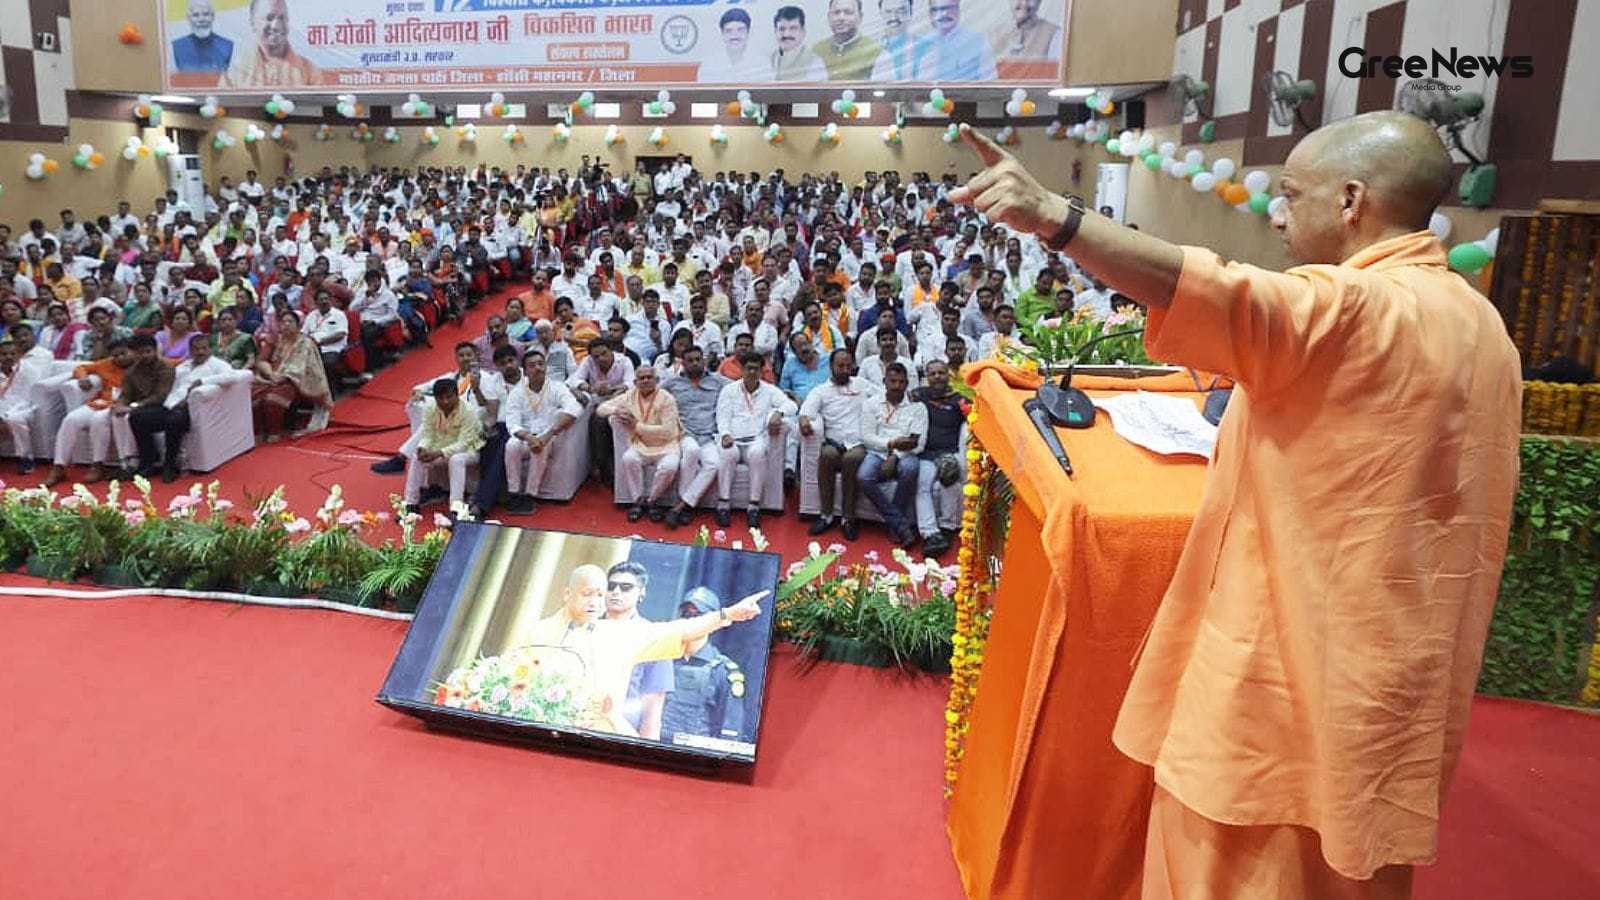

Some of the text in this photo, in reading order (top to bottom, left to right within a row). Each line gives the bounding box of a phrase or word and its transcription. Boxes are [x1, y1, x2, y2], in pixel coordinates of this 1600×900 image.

[384, 17, 479, 44] आदित्यनाथ
[486, 14, 510, 42] जी
[523, 12, 653, 36] विकसित भारत
[424, 50, 454, 62] सरकार
[599, 67, 635, 82] जिला
